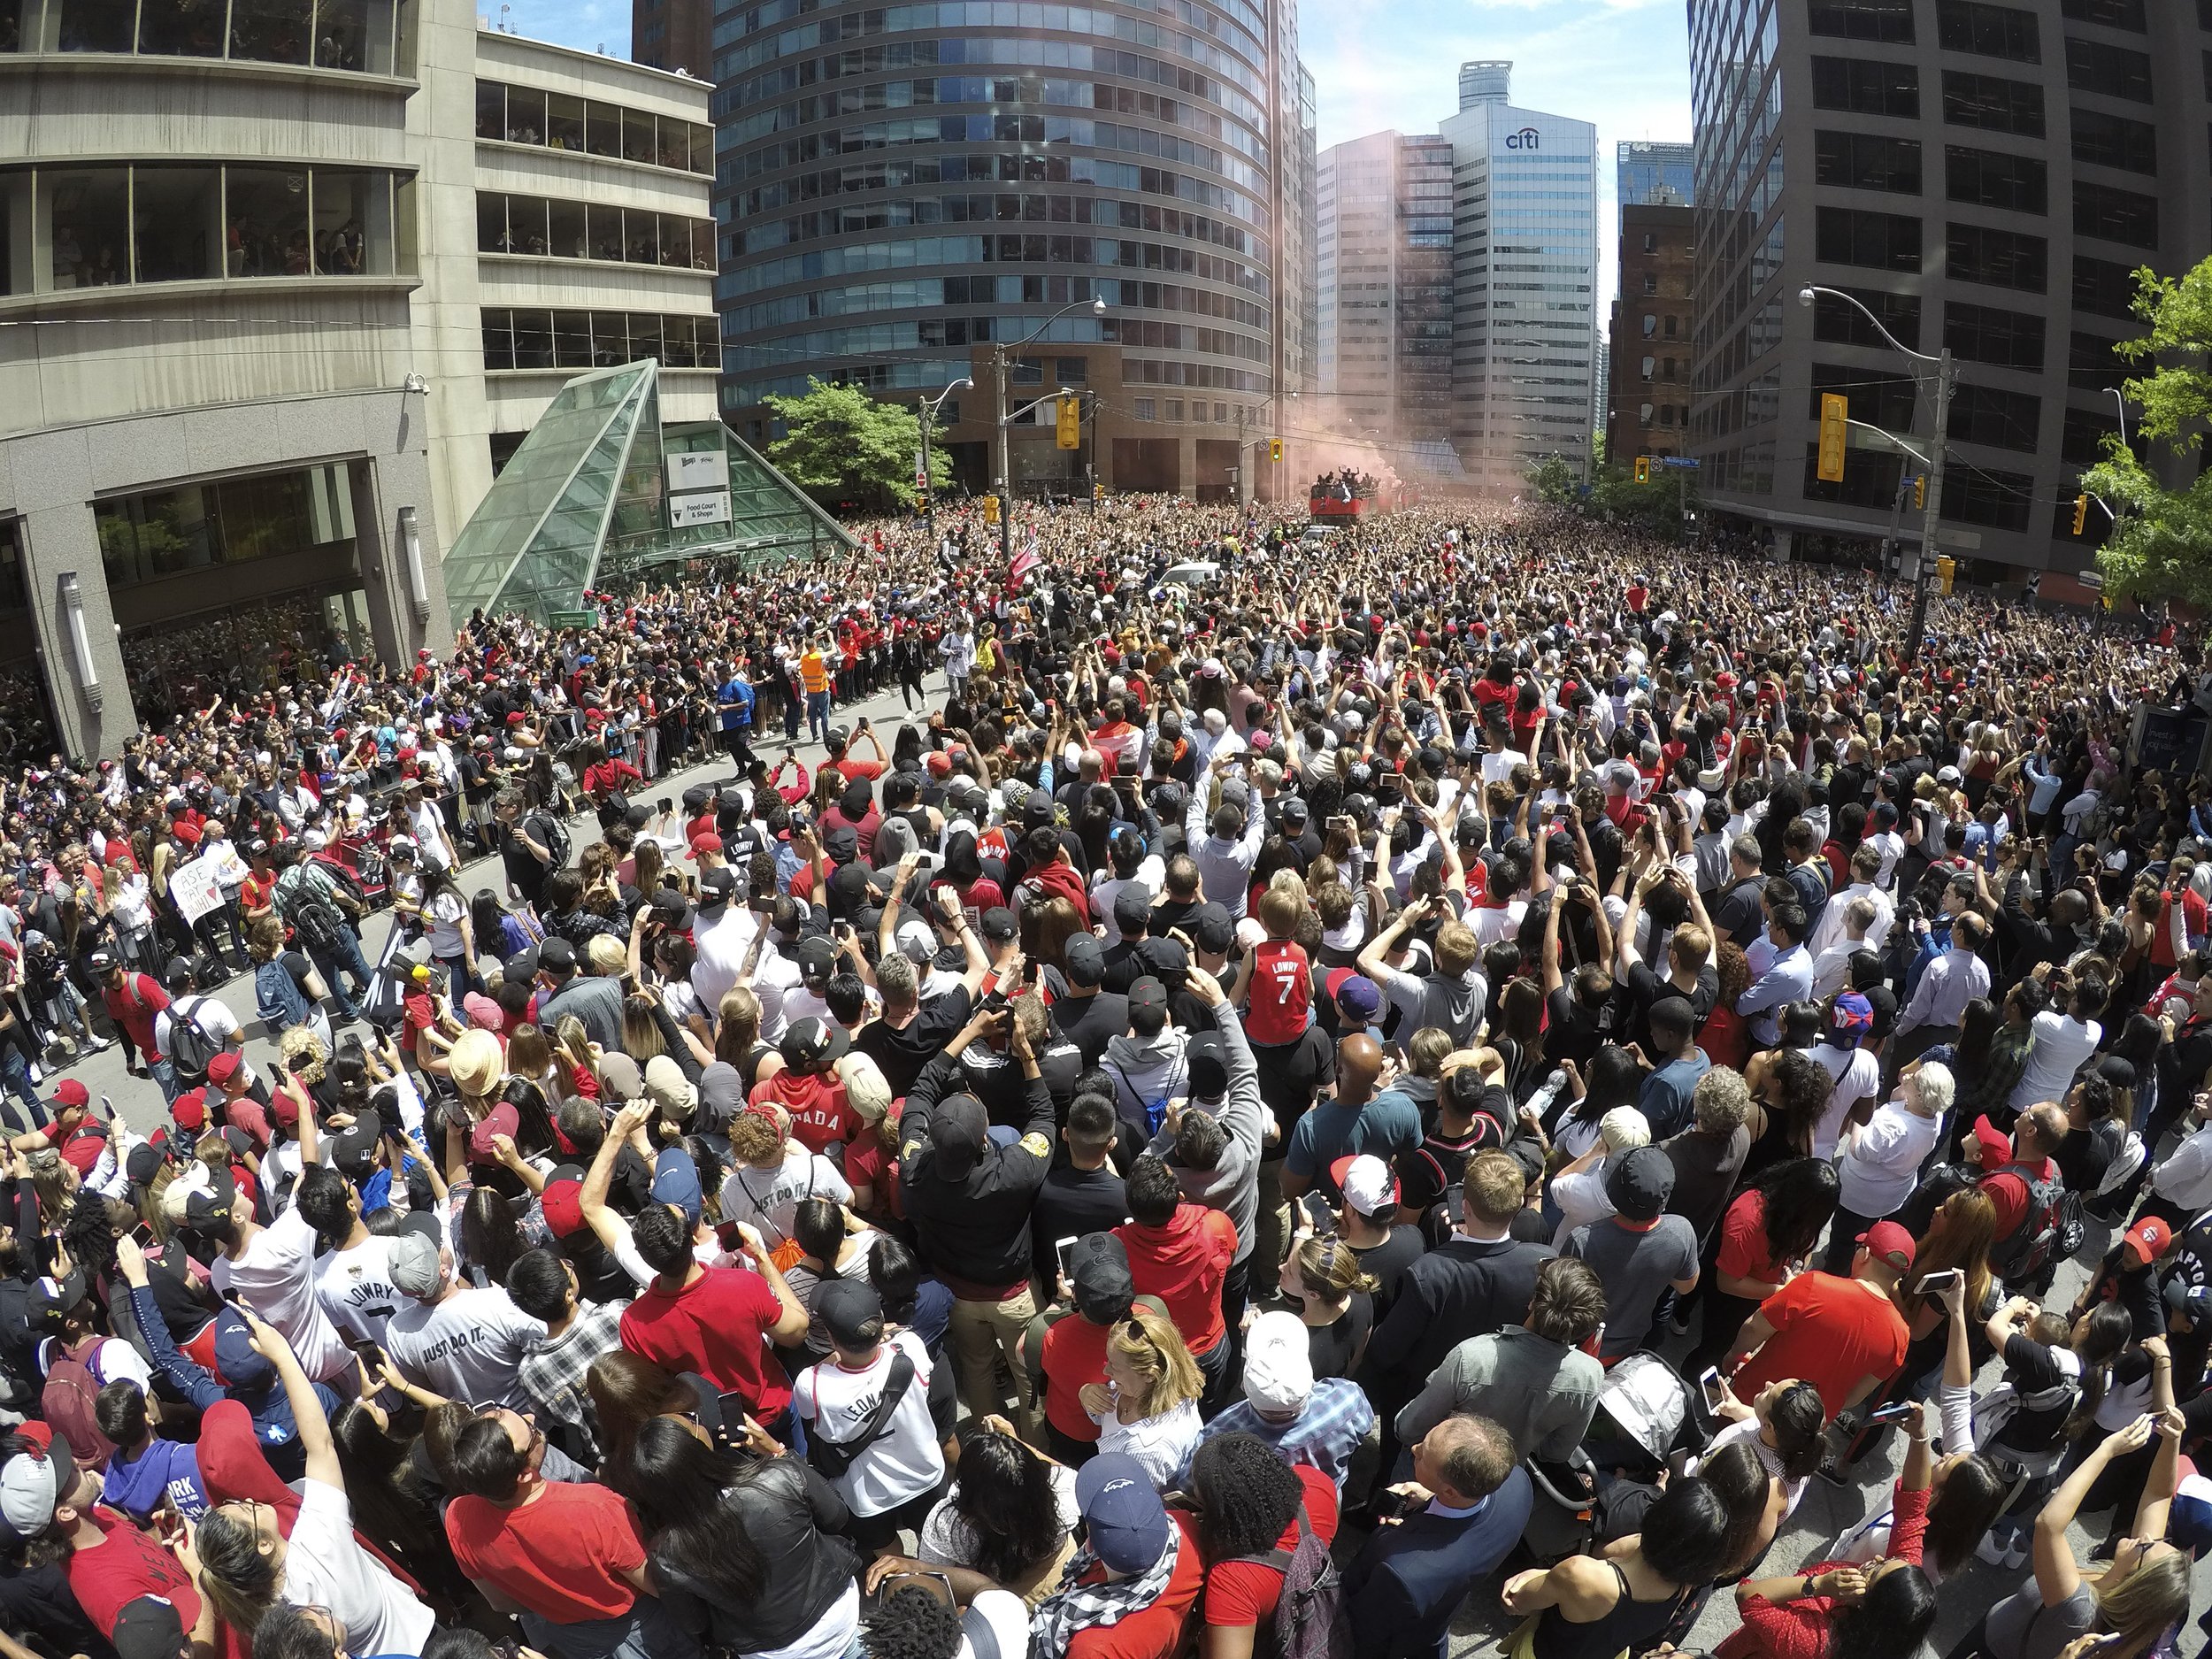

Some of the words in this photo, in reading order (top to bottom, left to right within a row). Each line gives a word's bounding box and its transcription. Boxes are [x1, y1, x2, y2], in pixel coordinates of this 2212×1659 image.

[1505, 131, 1540, 149] citi
[731, 841, 754, 856] LOWRY
[180, 864, 208, 888] ASE
[1271, 962, 1299, 974] LOWRY
[1277, 975, 1294, 1003] 7
[777, 1187, 792, 1202] DO
[795, 1181, 806, 1198] IT.
[343, 1282, 394, 1308] LOWRY
[422, 1338, 447, 1363] JUST
[450, 1333, 467, 1350] DO
[471, 1326, 486, 1344] IT.
